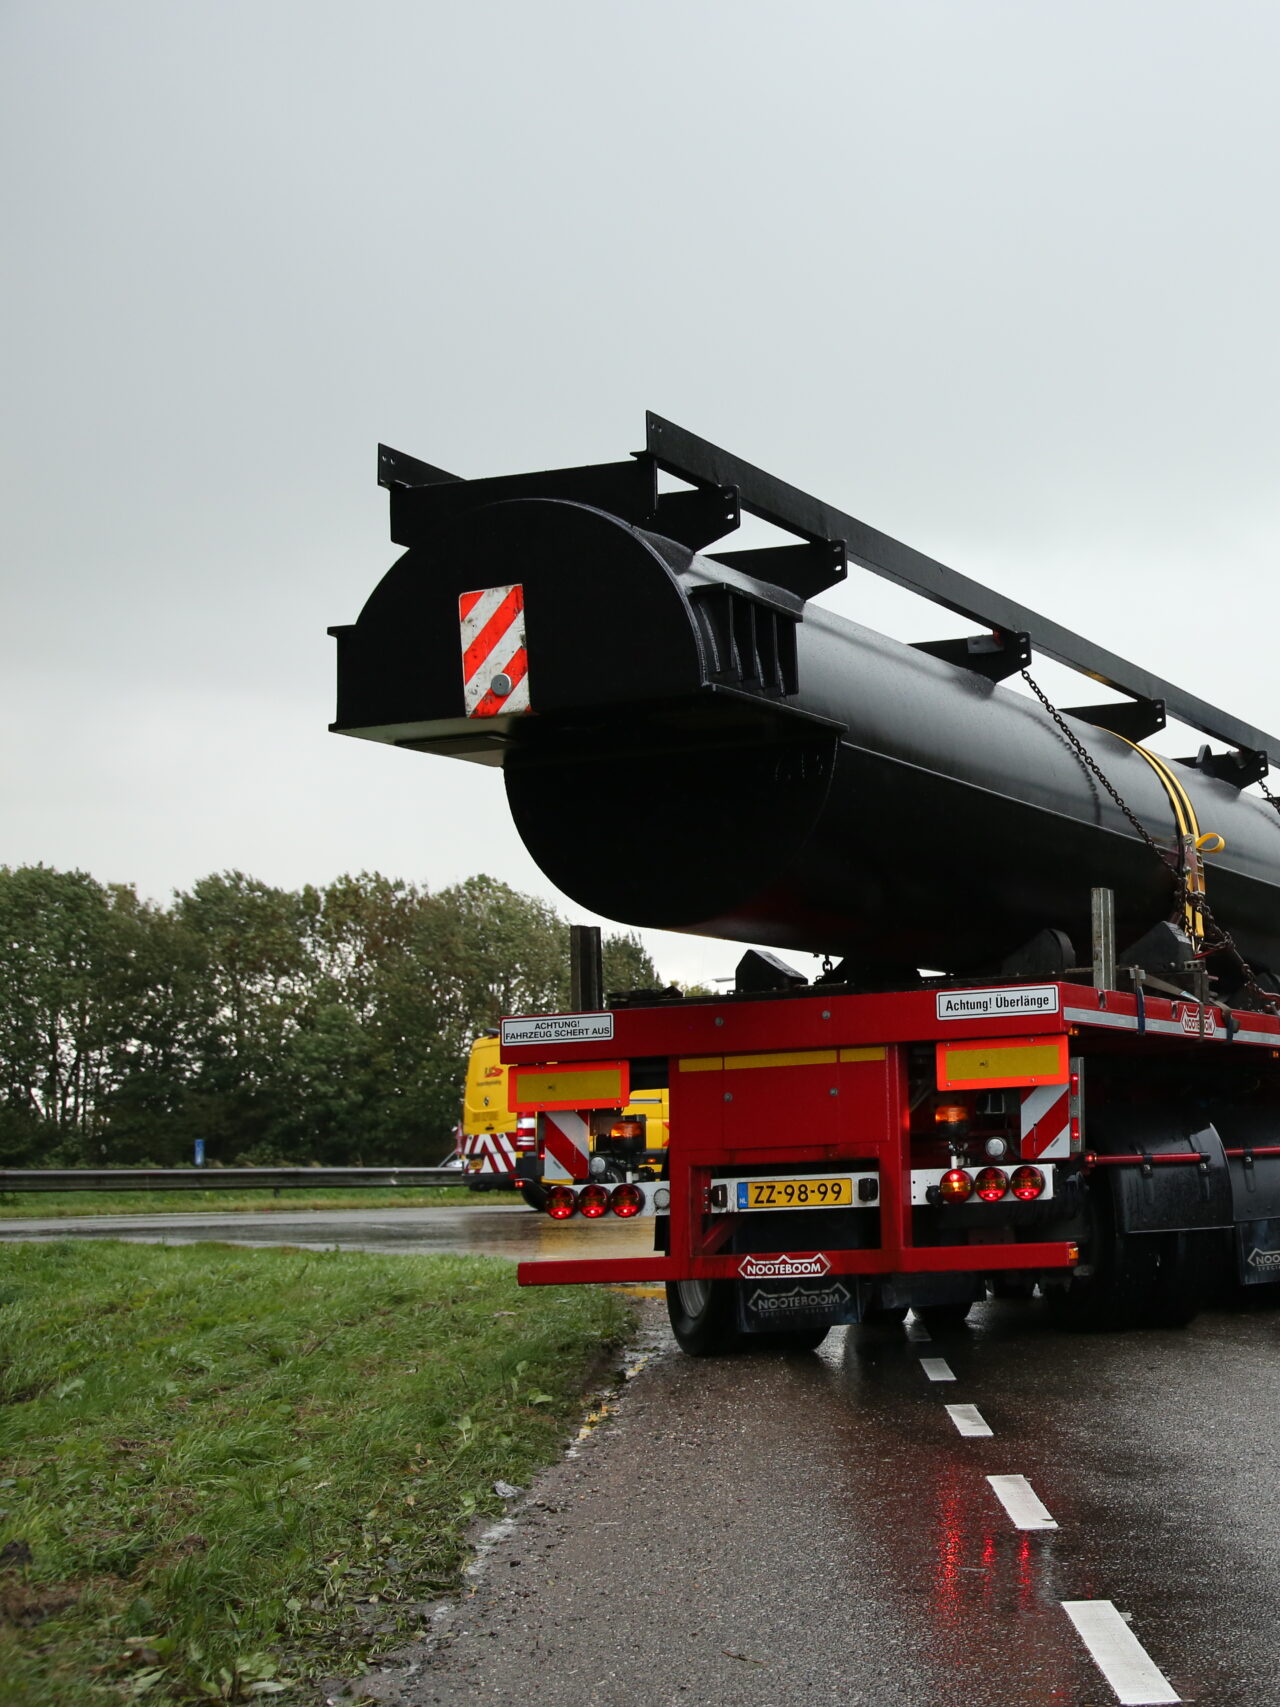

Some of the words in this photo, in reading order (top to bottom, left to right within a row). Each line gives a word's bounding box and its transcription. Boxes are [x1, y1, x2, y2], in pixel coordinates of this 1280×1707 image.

[945, 997, 992, 1012] Achtung!
[995, 994, 1049, 1008] Überlänge
[534, 1020, 580, 1030] ACHTUNG!
[505, 1030, 552, 1040] FAHRZEUG
[554, 1028, 589, 1038] SCHERT
[592, 1027, 610, 1035] AUS
[753, 1182, 842, 1204] ZZ-98-99
[747, 1263, 821, 1275] NOOTEBOOM
[758, 1294, 840, 1309] NOOTEBOOM
